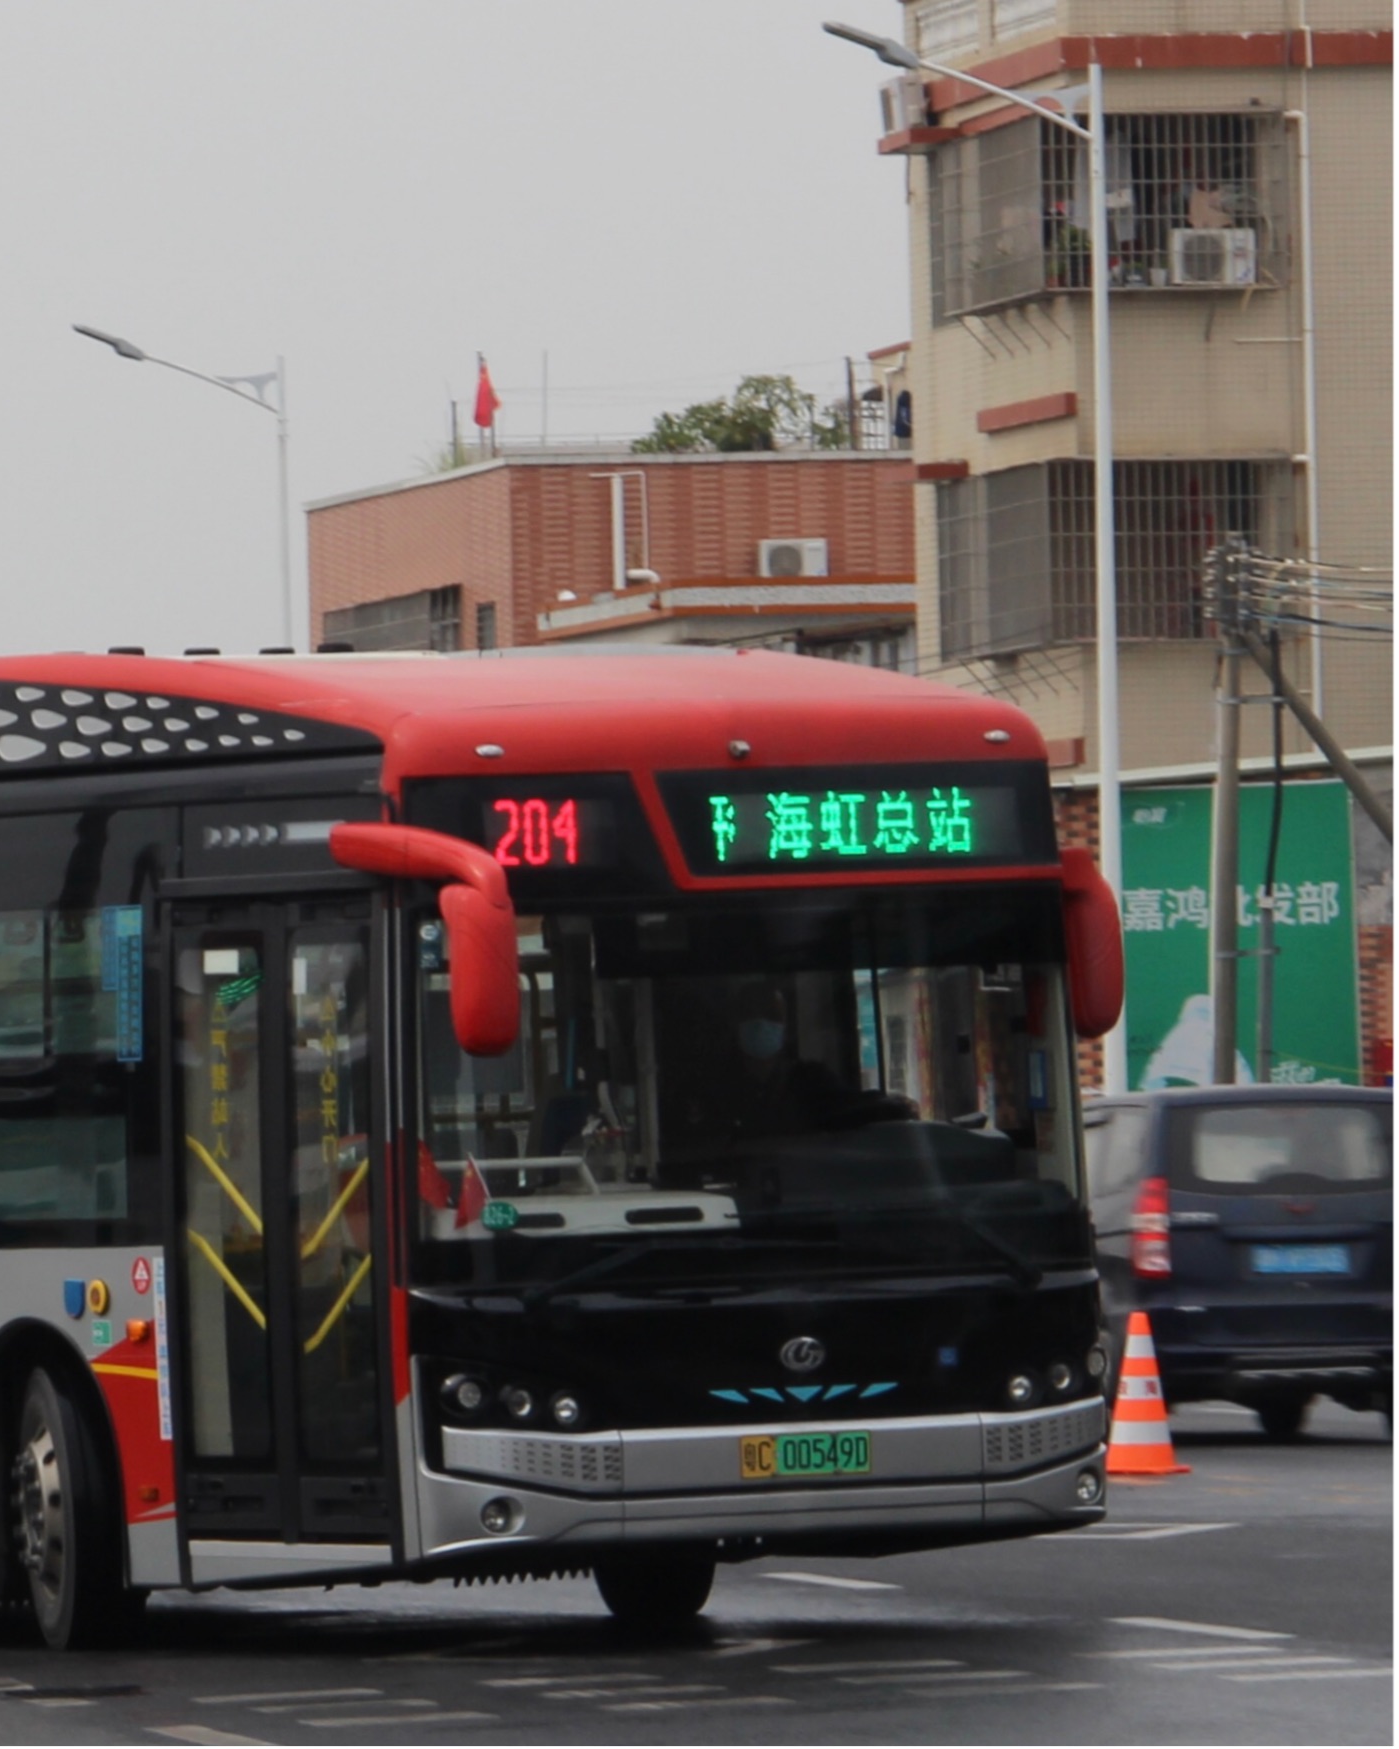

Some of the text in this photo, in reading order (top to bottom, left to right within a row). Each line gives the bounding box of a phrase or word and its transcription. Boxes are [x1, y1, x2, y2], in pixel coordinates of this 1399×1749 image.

[494, 799, 577, 866] 204
[765, 787, 971, 859] 海虹总站
